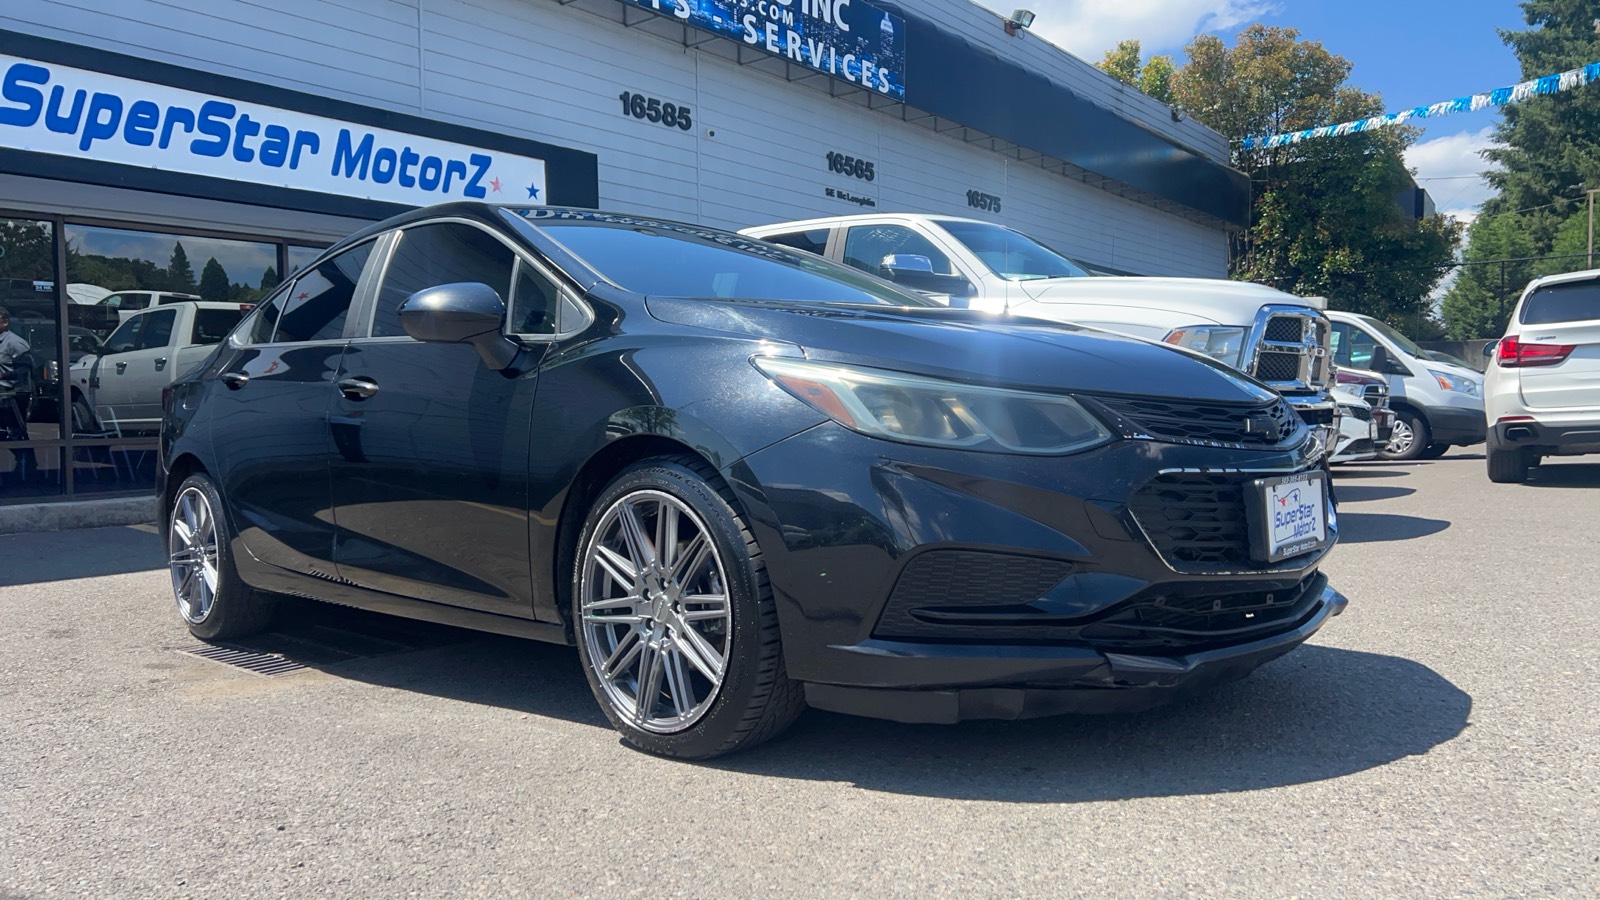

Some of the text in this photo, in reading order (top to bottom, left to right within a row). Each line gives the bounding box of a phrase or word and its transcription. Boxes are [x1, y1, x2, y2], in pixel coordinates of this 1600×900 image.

[743, 14, 890, 94] SERVICES
[619, 91, 692, 131] 16585
[0, 62, 492, 199] SuperStar MotorZ
[826, 151, 875, 182] 16565
[966, 189, 1001, 214] 16575
[1275, 504, 1315, 530] SuperStar
